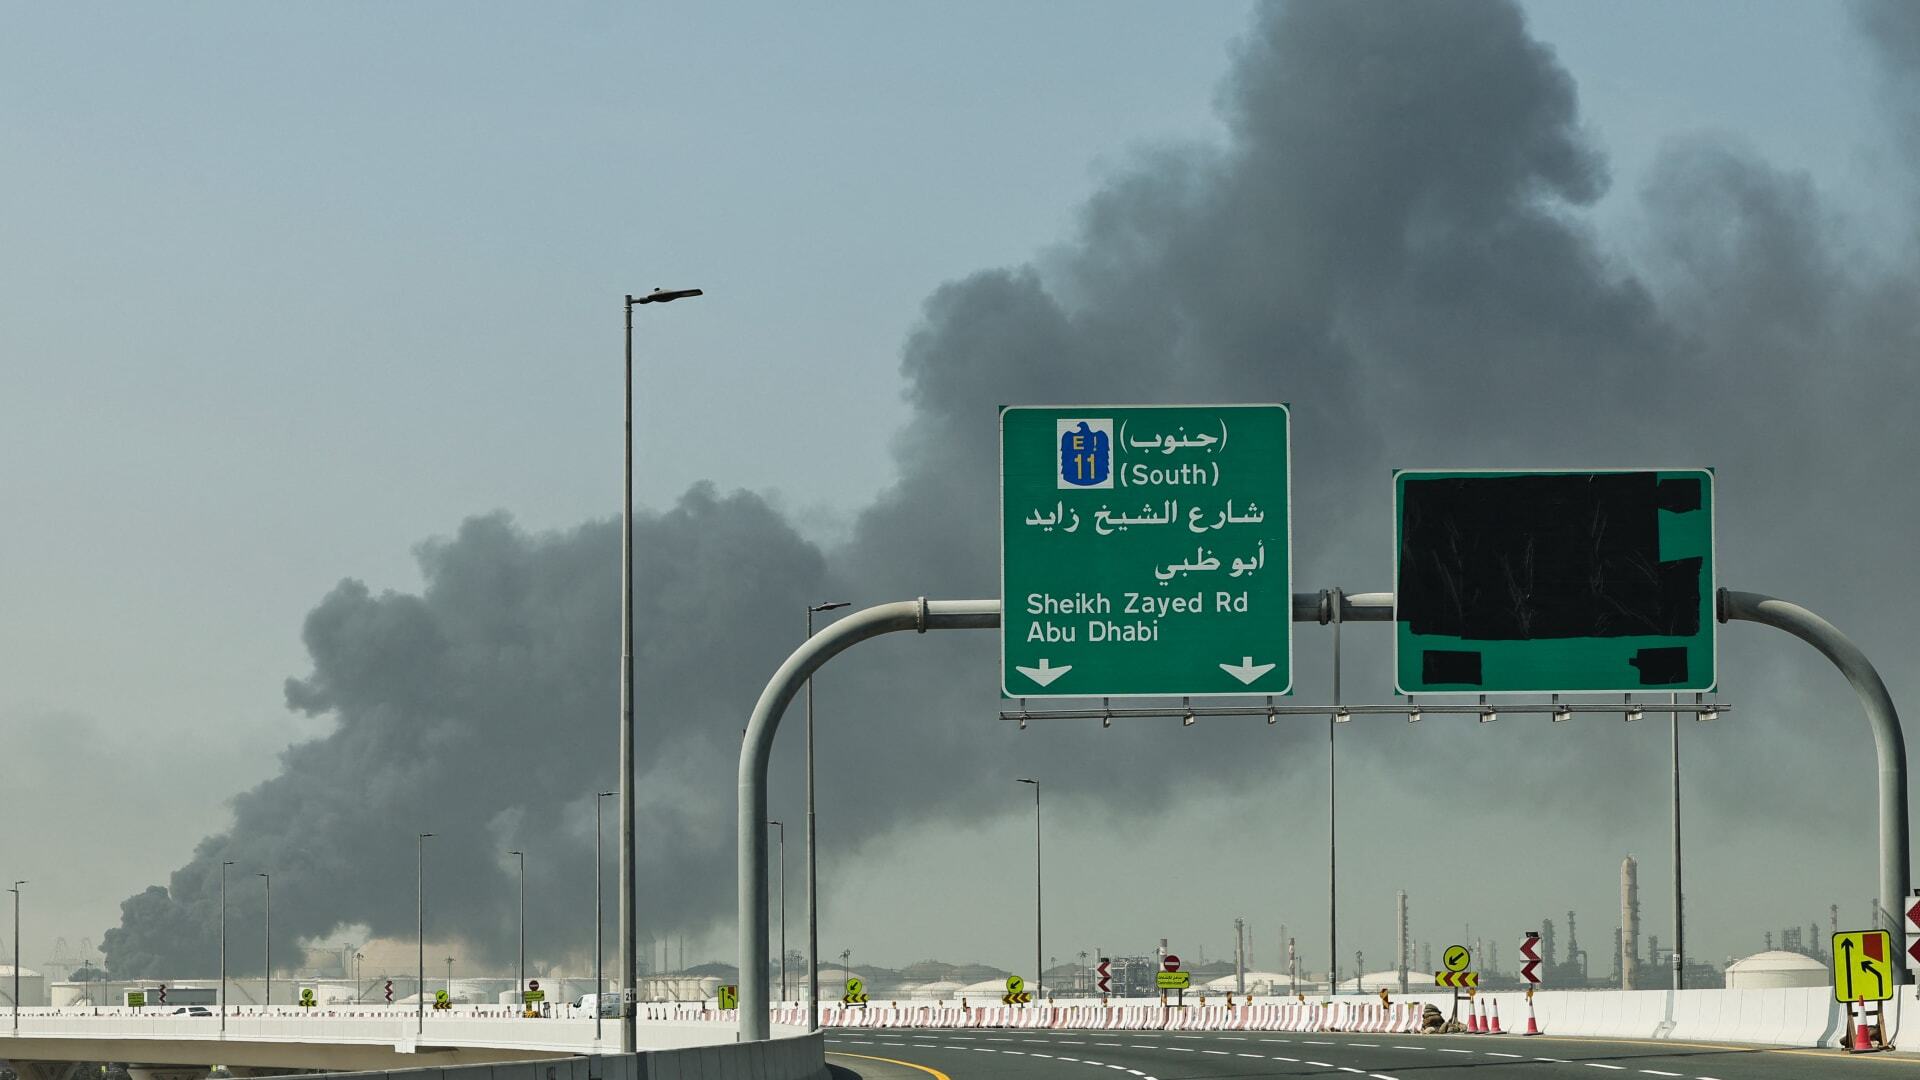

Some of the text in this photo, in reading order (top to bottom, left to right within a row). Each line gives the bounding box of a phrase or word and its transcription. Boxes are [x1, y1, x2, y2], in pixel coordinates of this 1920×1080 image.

[1073, 436, 1084, 450] E
[1120, 419, 1227, 454] (جنوب)
[1074, 453, 1095, 480] 11
[1121, 462, 1218, 486] (South)
[1026, 500, 1264, 535] شارع الشيخ زايد
[1155, 540, 1264, 585] أبو ظبي
[1027, 592, 1247, 617] Sheikh Zayed Rd
[1027, 620, 1157, 642] Abu Dhabi
